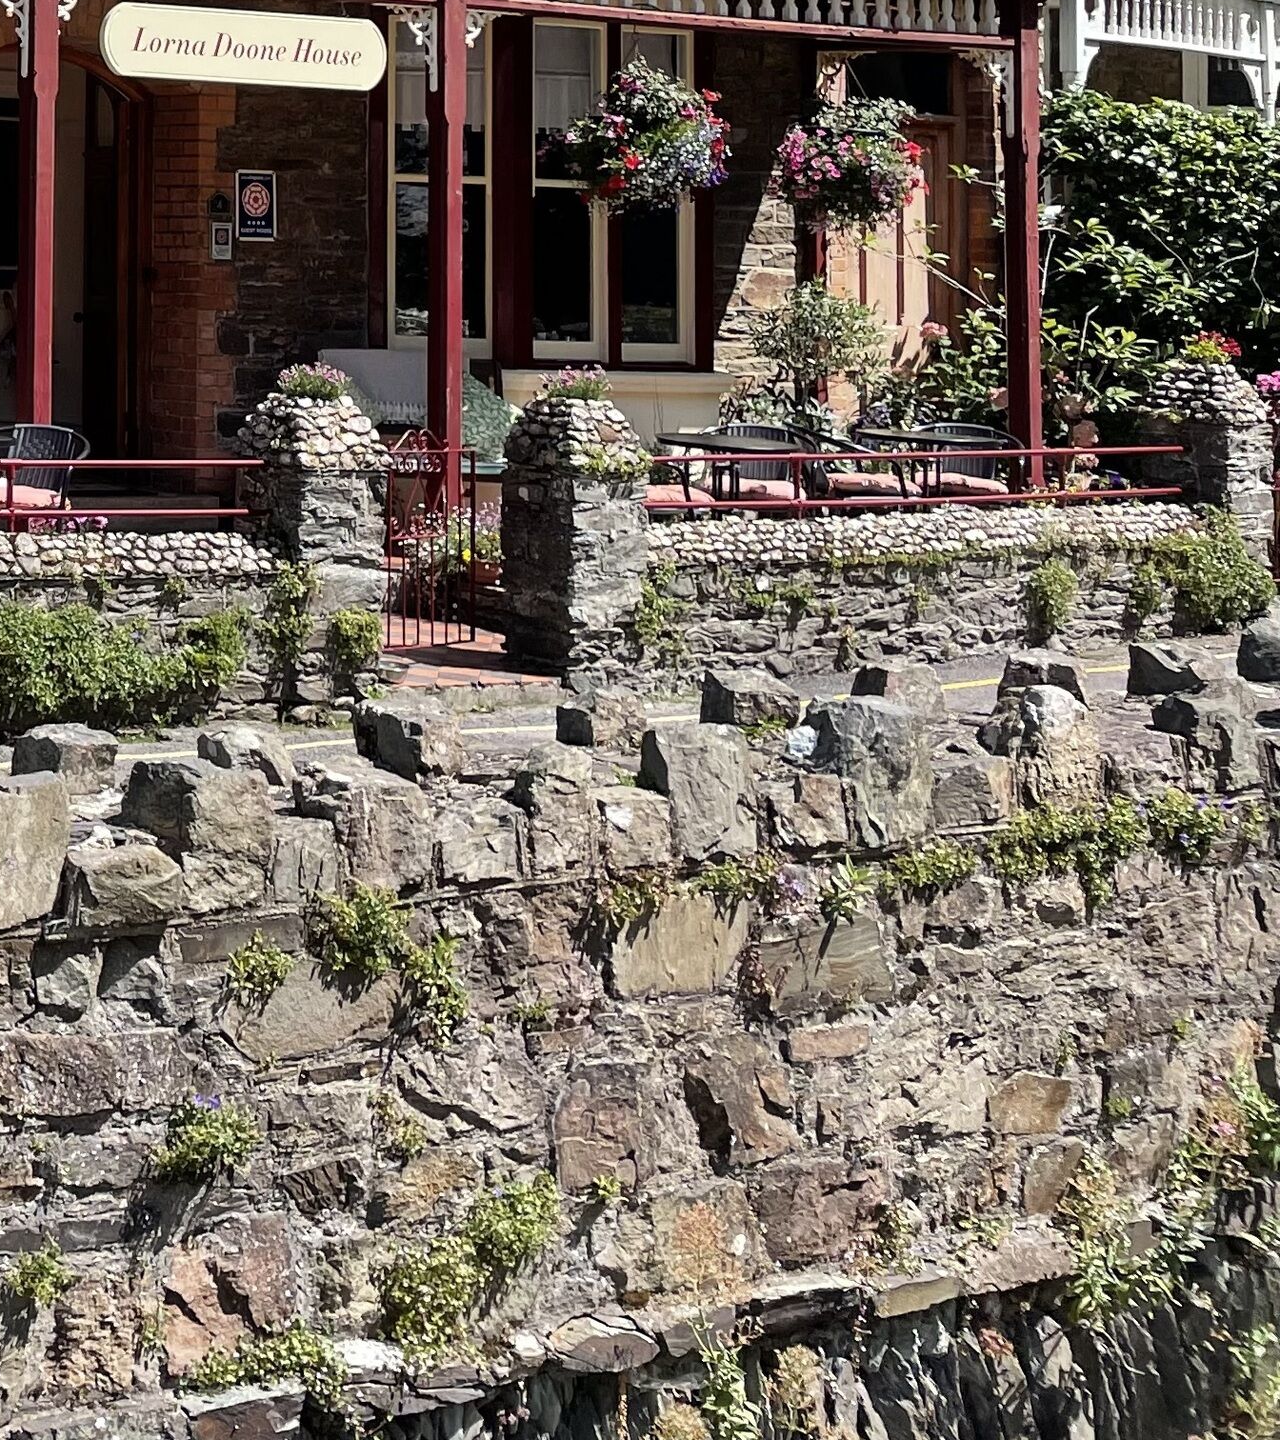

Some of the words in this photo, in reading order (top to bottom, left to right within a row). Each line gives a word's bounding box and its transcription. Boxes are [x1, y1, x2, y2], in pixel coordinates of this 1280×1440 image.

[132, 26, 206, 58] Lorna
[212, 31, 287, 62] Doone
[290, 37, 362, 68] House
